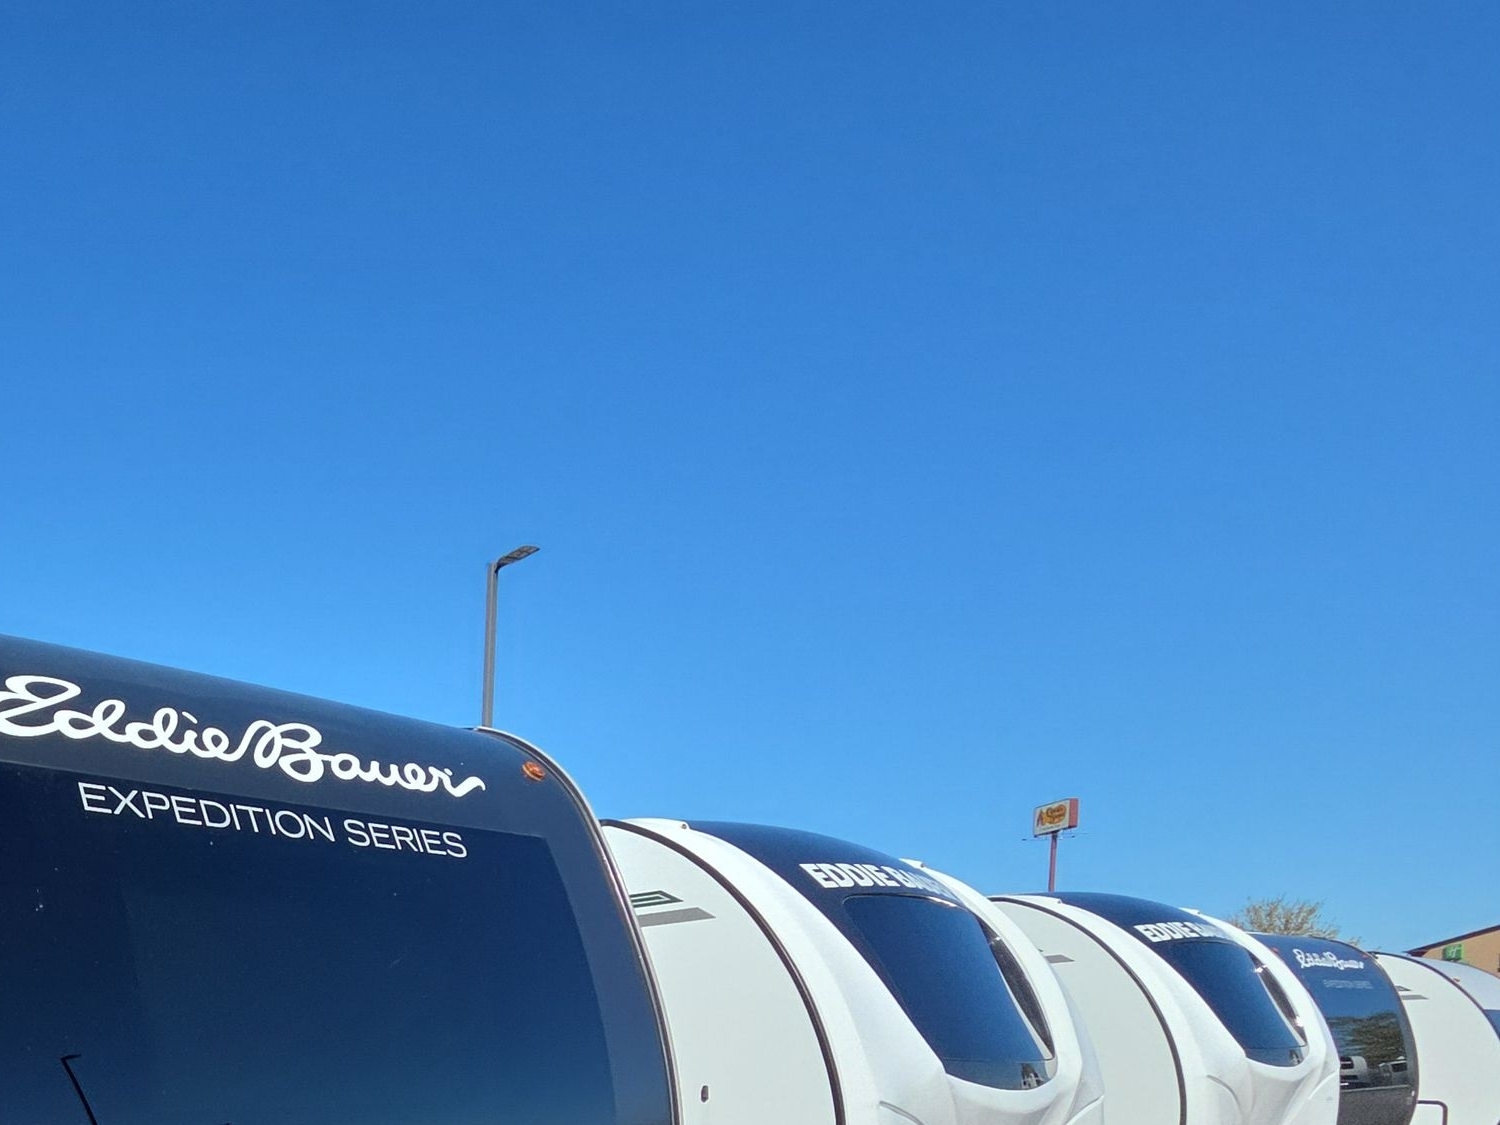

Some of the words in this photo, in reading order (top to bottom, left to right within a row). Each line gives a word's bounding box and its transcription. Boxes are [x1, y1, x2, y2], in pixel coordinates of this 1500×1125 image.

[235, 720, 486, 797] Bauer
[77, 782, 336, 843] EXPEDITION
[343, 819, 468, 858] SERIES
[799, 863, 901, 889] EDDIE
[1133, 921, 1201, 943] EDDIE
